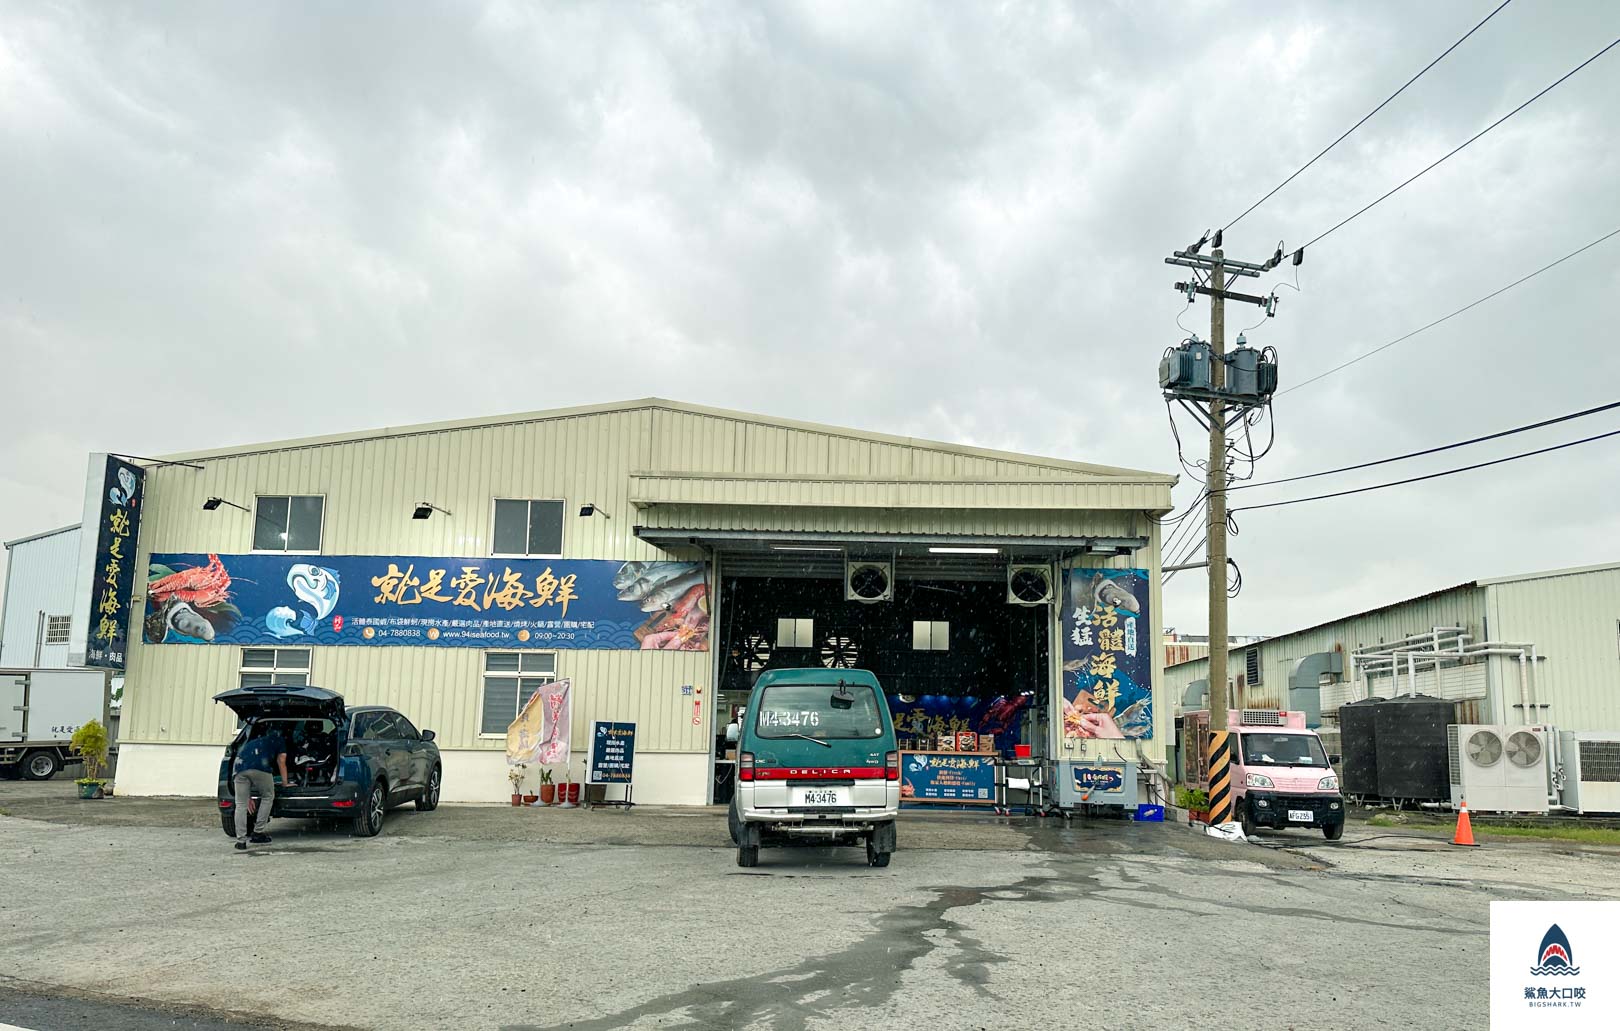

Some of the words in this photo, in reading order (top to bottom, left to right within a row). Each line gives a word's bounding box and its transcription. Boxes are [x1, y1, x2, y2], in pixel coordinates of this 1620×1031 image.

[96, 508, 130, 647] 就是愛海鮮
[371, 563, 579, 619] 就是愛海鮮
[378, 629, 421, 637] 04-7880838
[1070, 605, 1094, 646] 生猛
[1090, 605, 1125, 711] 活體海鮮
